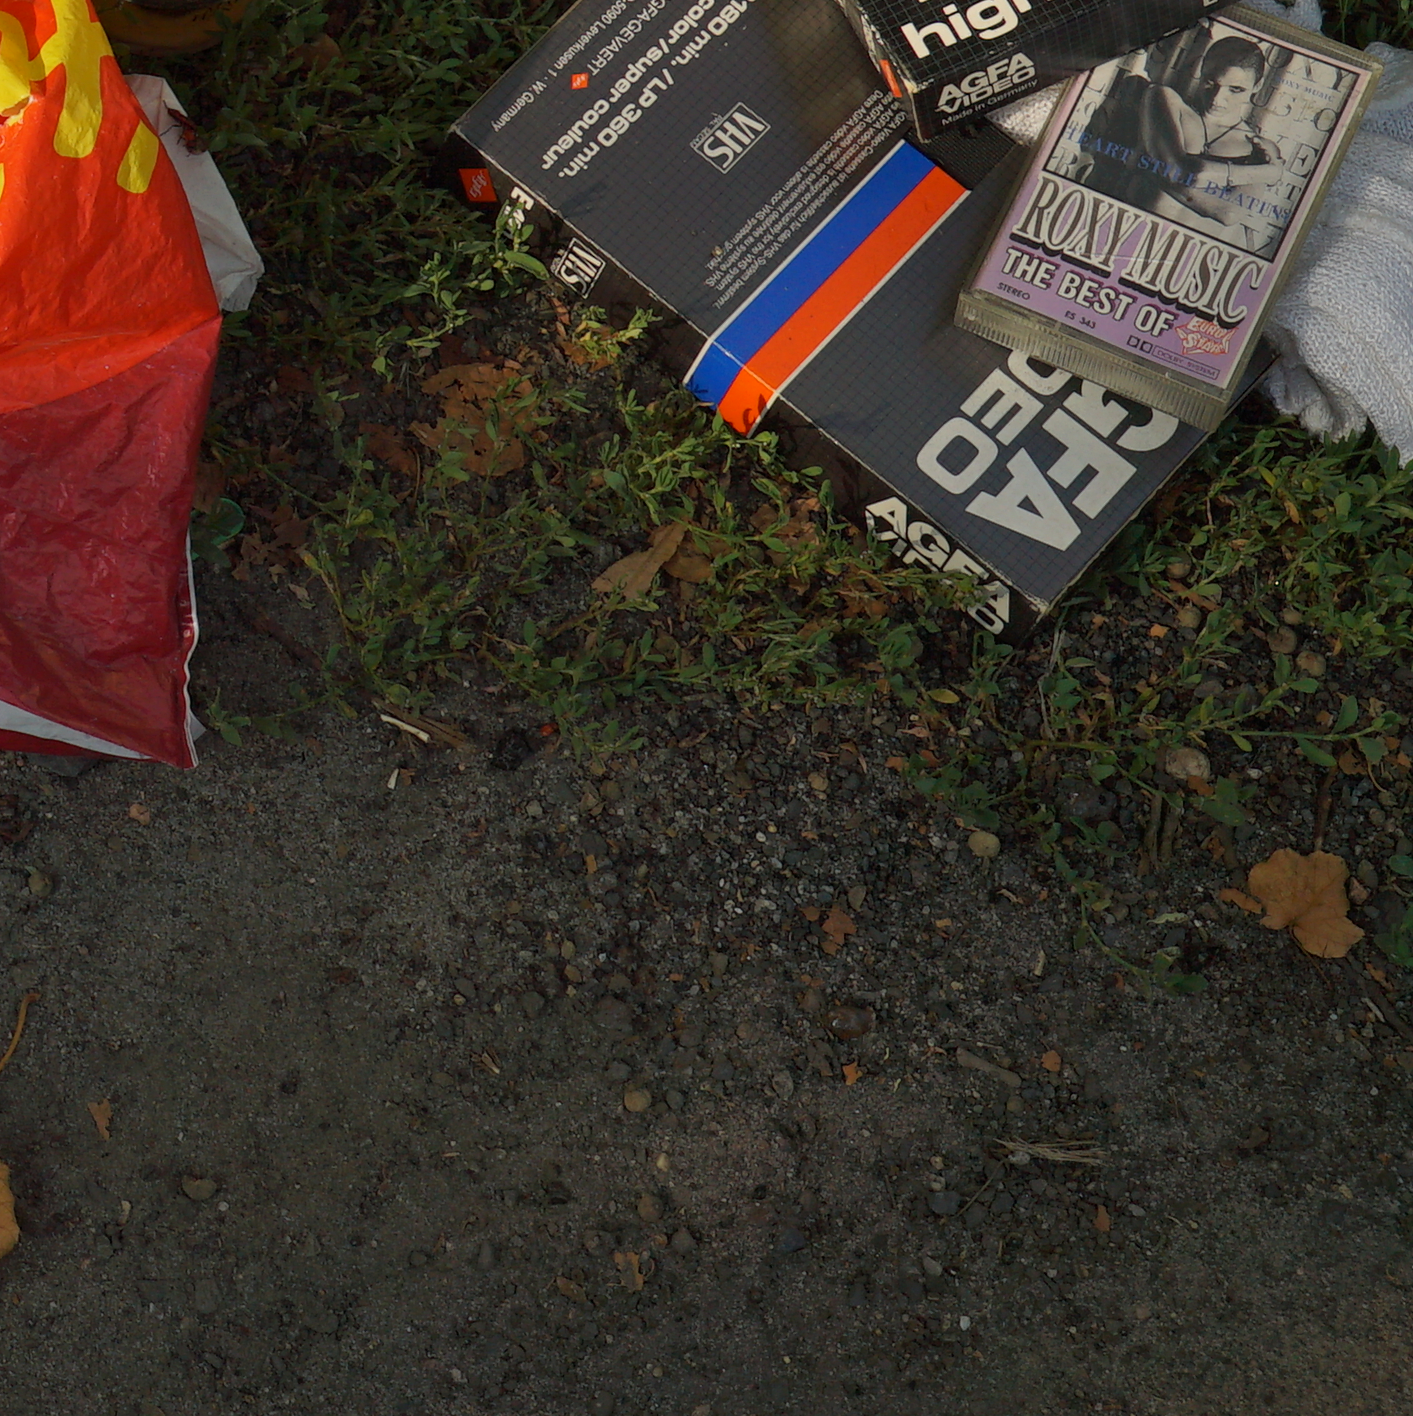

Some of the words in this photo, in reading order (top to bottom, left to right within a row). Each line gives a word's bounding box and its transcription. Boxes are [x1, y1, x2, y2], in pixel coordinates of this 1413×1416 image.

[547, 68, 558, 76] 1
[552, 18, 605, 71] Leverkusen
[668, 29, 716, 72] min.
[934, 48, 1034, 106] AGFA
[936, 65, 1037, 118] VIDEO
[535, 96, 613, 173] couleur
[594, 101, 643, 147] 360
[711, 108, 763, 170] VHS
[556, 140, 603, 184] min.
[1060, 127, 1135, 163] HEART
[1135, 153, 1200, 188] STILL
[568, 240, 605, 298] VHS
[1011, 175, 1146, 276] ROXY
[1118, 218, 1271, 331] MUSIC
[996, 282, 1030, 301] STEREO
[998, 247, 1059, 291] THE
[1055, 270, 1134, 322] BEST
[1131, 303, 1177, 342] OF
